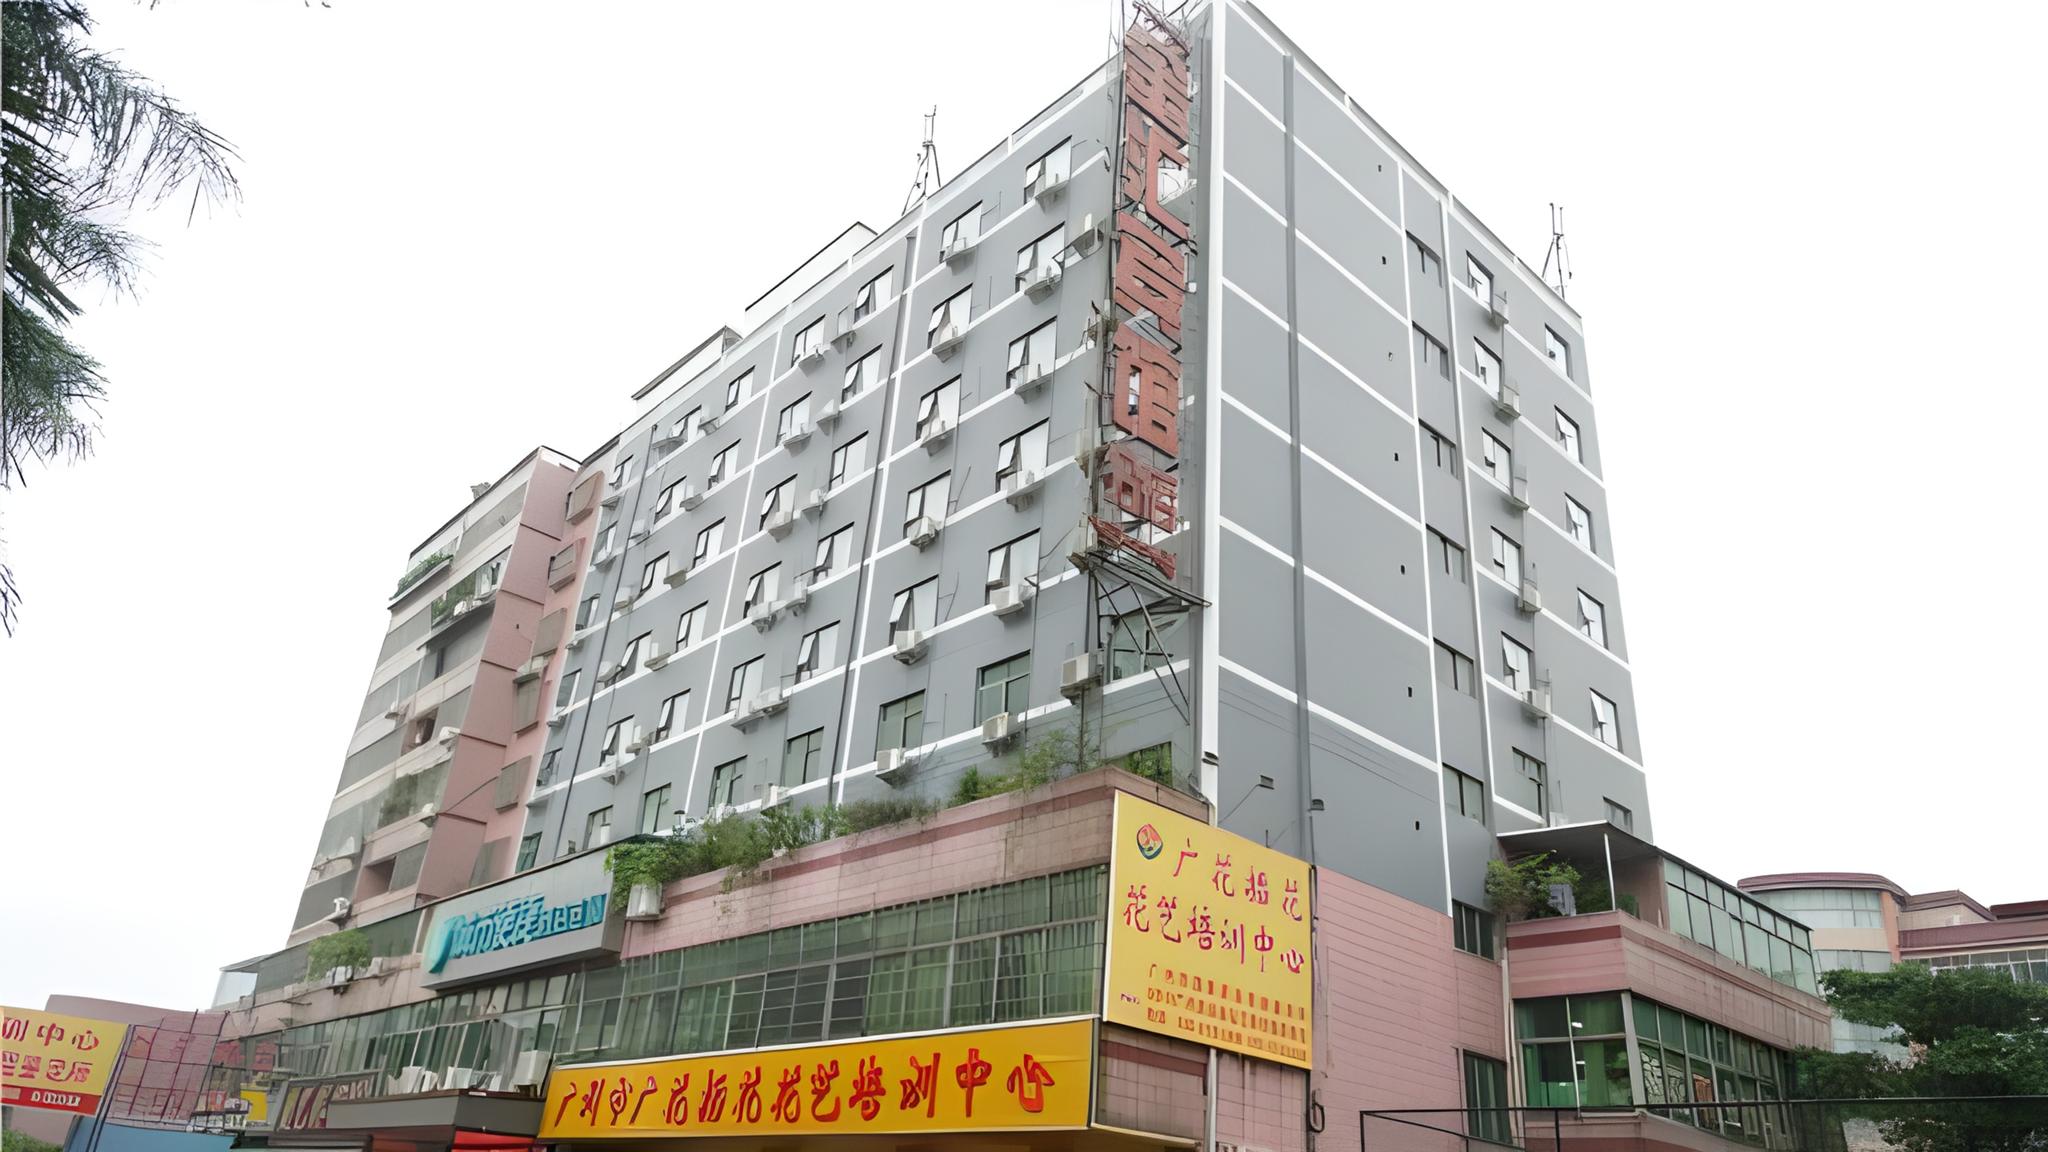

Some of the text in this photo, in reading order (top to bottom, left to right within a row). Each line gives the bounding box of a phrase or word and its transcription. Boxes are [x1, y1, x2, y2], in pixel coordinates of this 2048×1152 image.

[1122, 884, 1305, 974] 花艺培训中心
